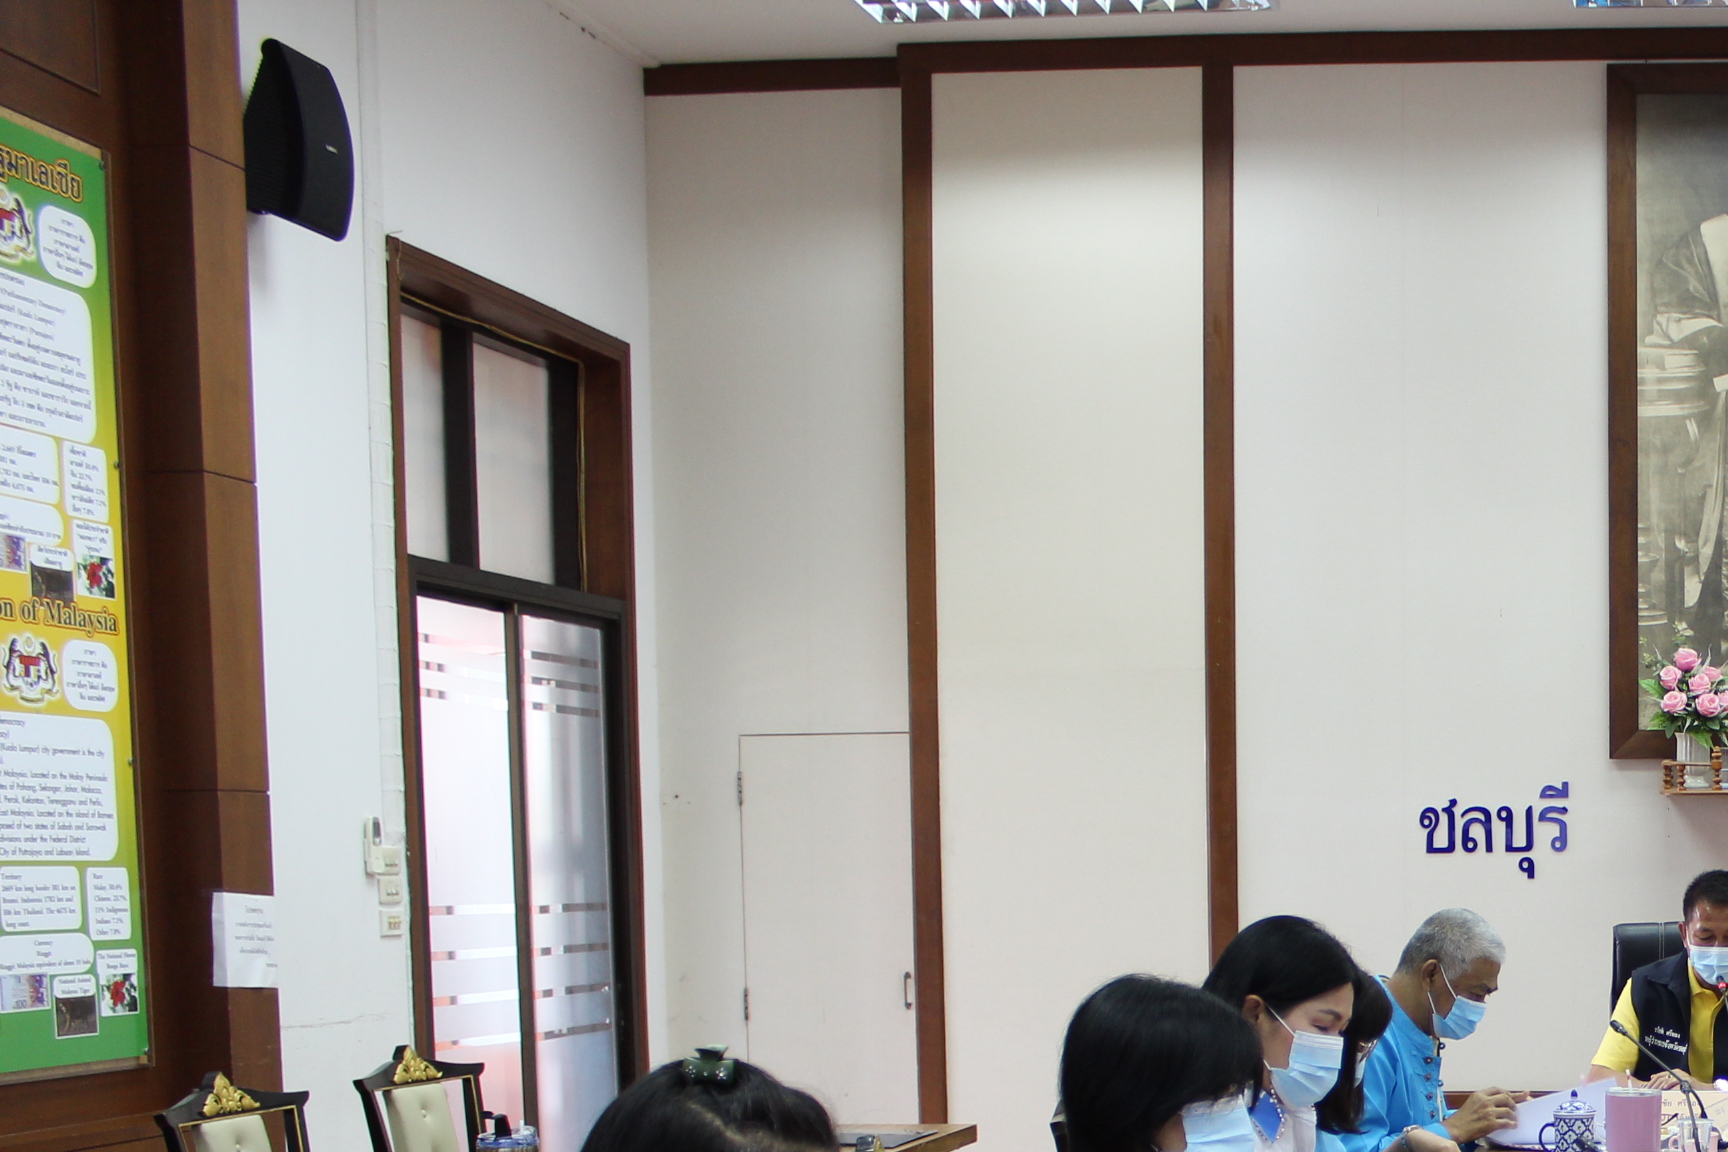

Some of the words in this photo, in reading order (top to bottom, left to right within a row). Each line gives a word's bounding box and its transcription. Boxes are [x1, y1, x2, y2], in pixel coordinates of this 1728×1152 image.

[21, 597, 40, 623] of
[44, 599, 118, 637] Malaysia
[1419, 781, 1569, 879] ชลบุรี
